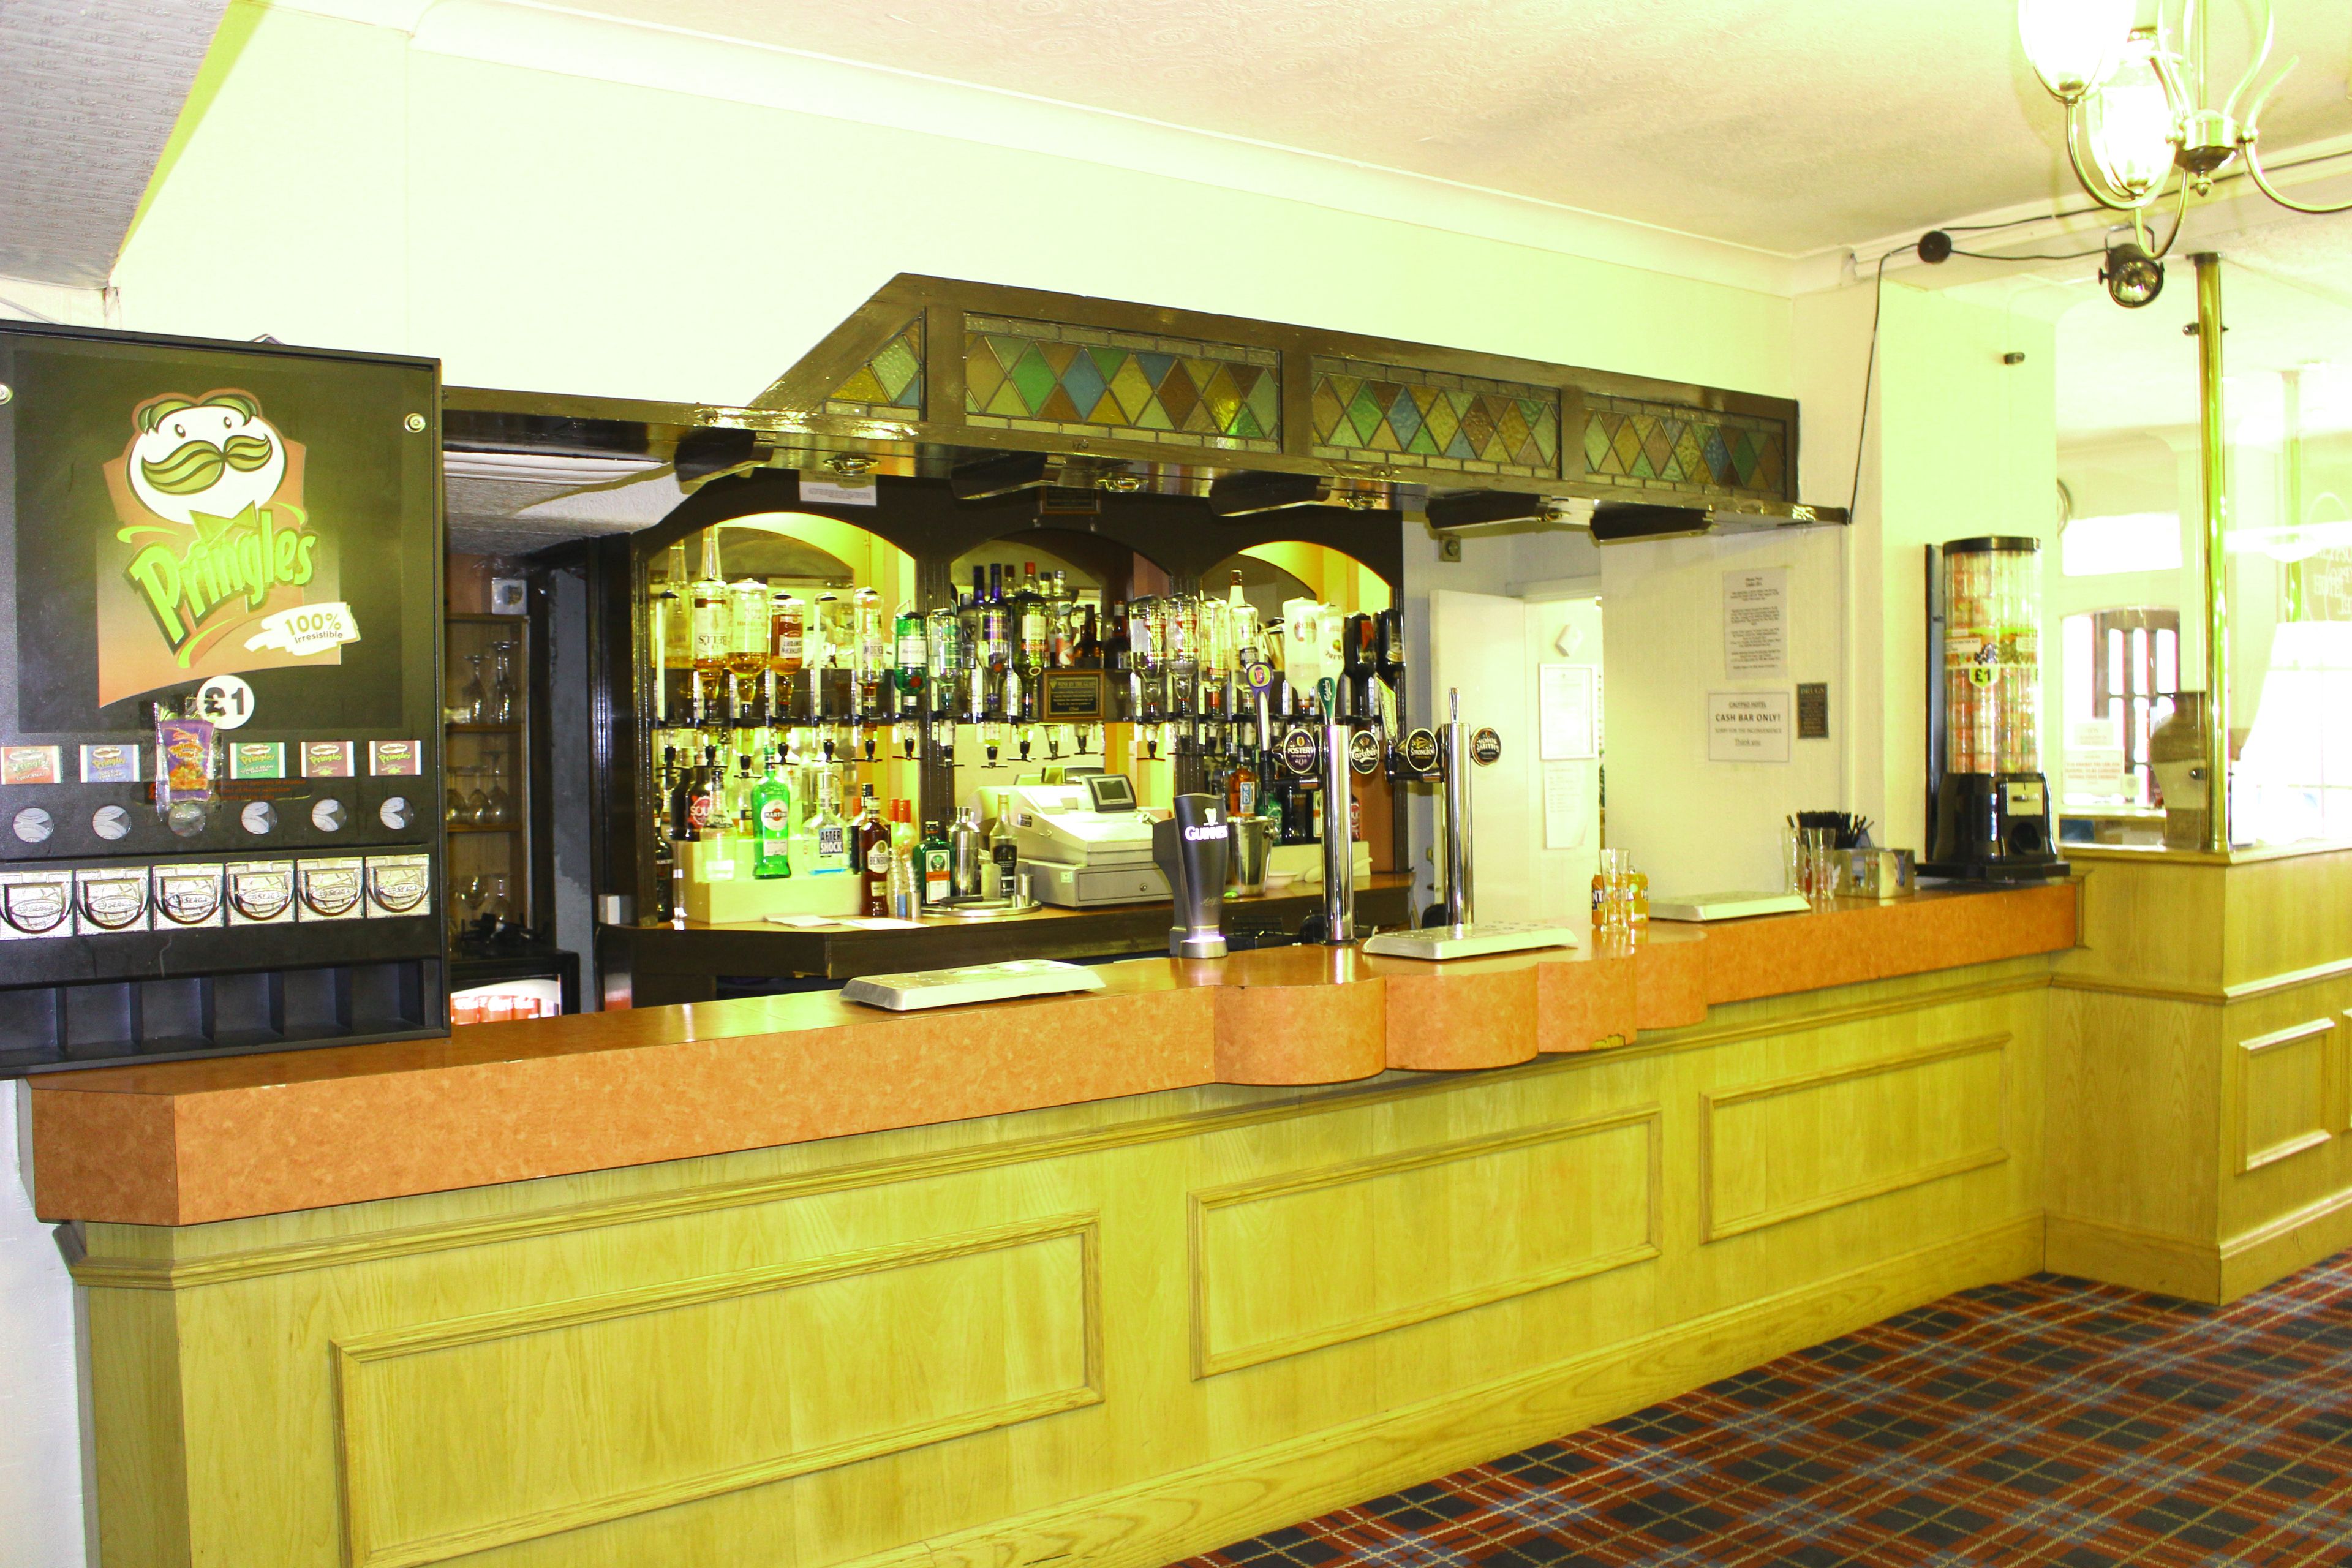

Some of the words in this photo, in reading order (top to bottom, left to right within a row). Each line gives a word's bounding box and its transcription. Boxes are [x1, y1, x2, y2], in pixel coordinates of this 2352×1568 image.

[127, 511, 317, 647] Pringles
[285, 612, 341, 635] 100%
[295, 630, 343, 643] Irresistible
[1975, 669, 1991, 682] £1
[205, 687, 244, 715] £1
[1757, 713, 1781, 722] ONLY!
[690, 805, 709, 816] SOU
[821, 831, 842, 842] AFTER
[820, 842, 843, 853] SHOCK
